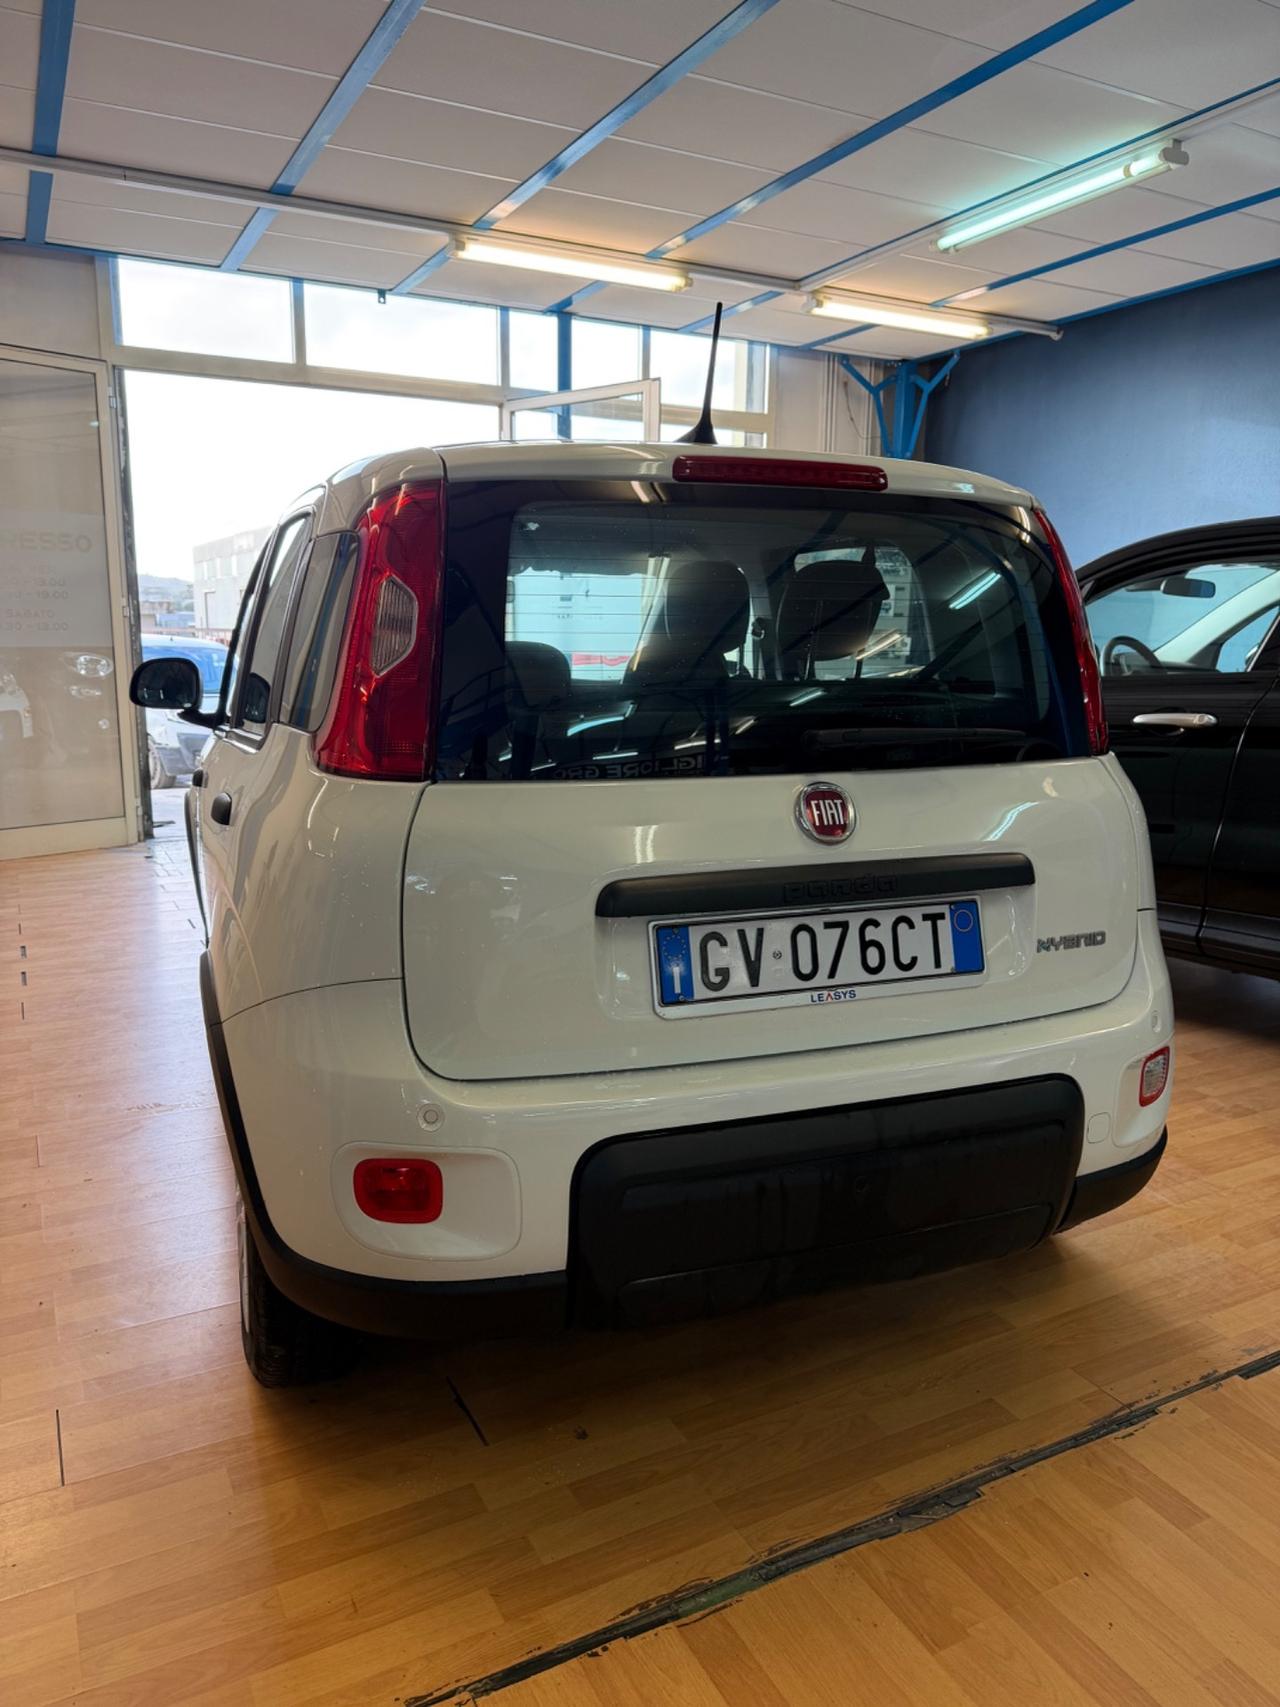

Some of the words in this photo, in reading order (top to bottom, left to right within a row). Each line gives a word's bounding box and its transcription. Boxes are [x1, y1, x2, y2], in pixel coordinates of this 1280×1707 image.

[810, 799, 844, 826] FIAT
[699, 927, 765, 993] GV
[789, 911, 946, 983] 076CT
[810, 989, 857, 1003] LEASYS
